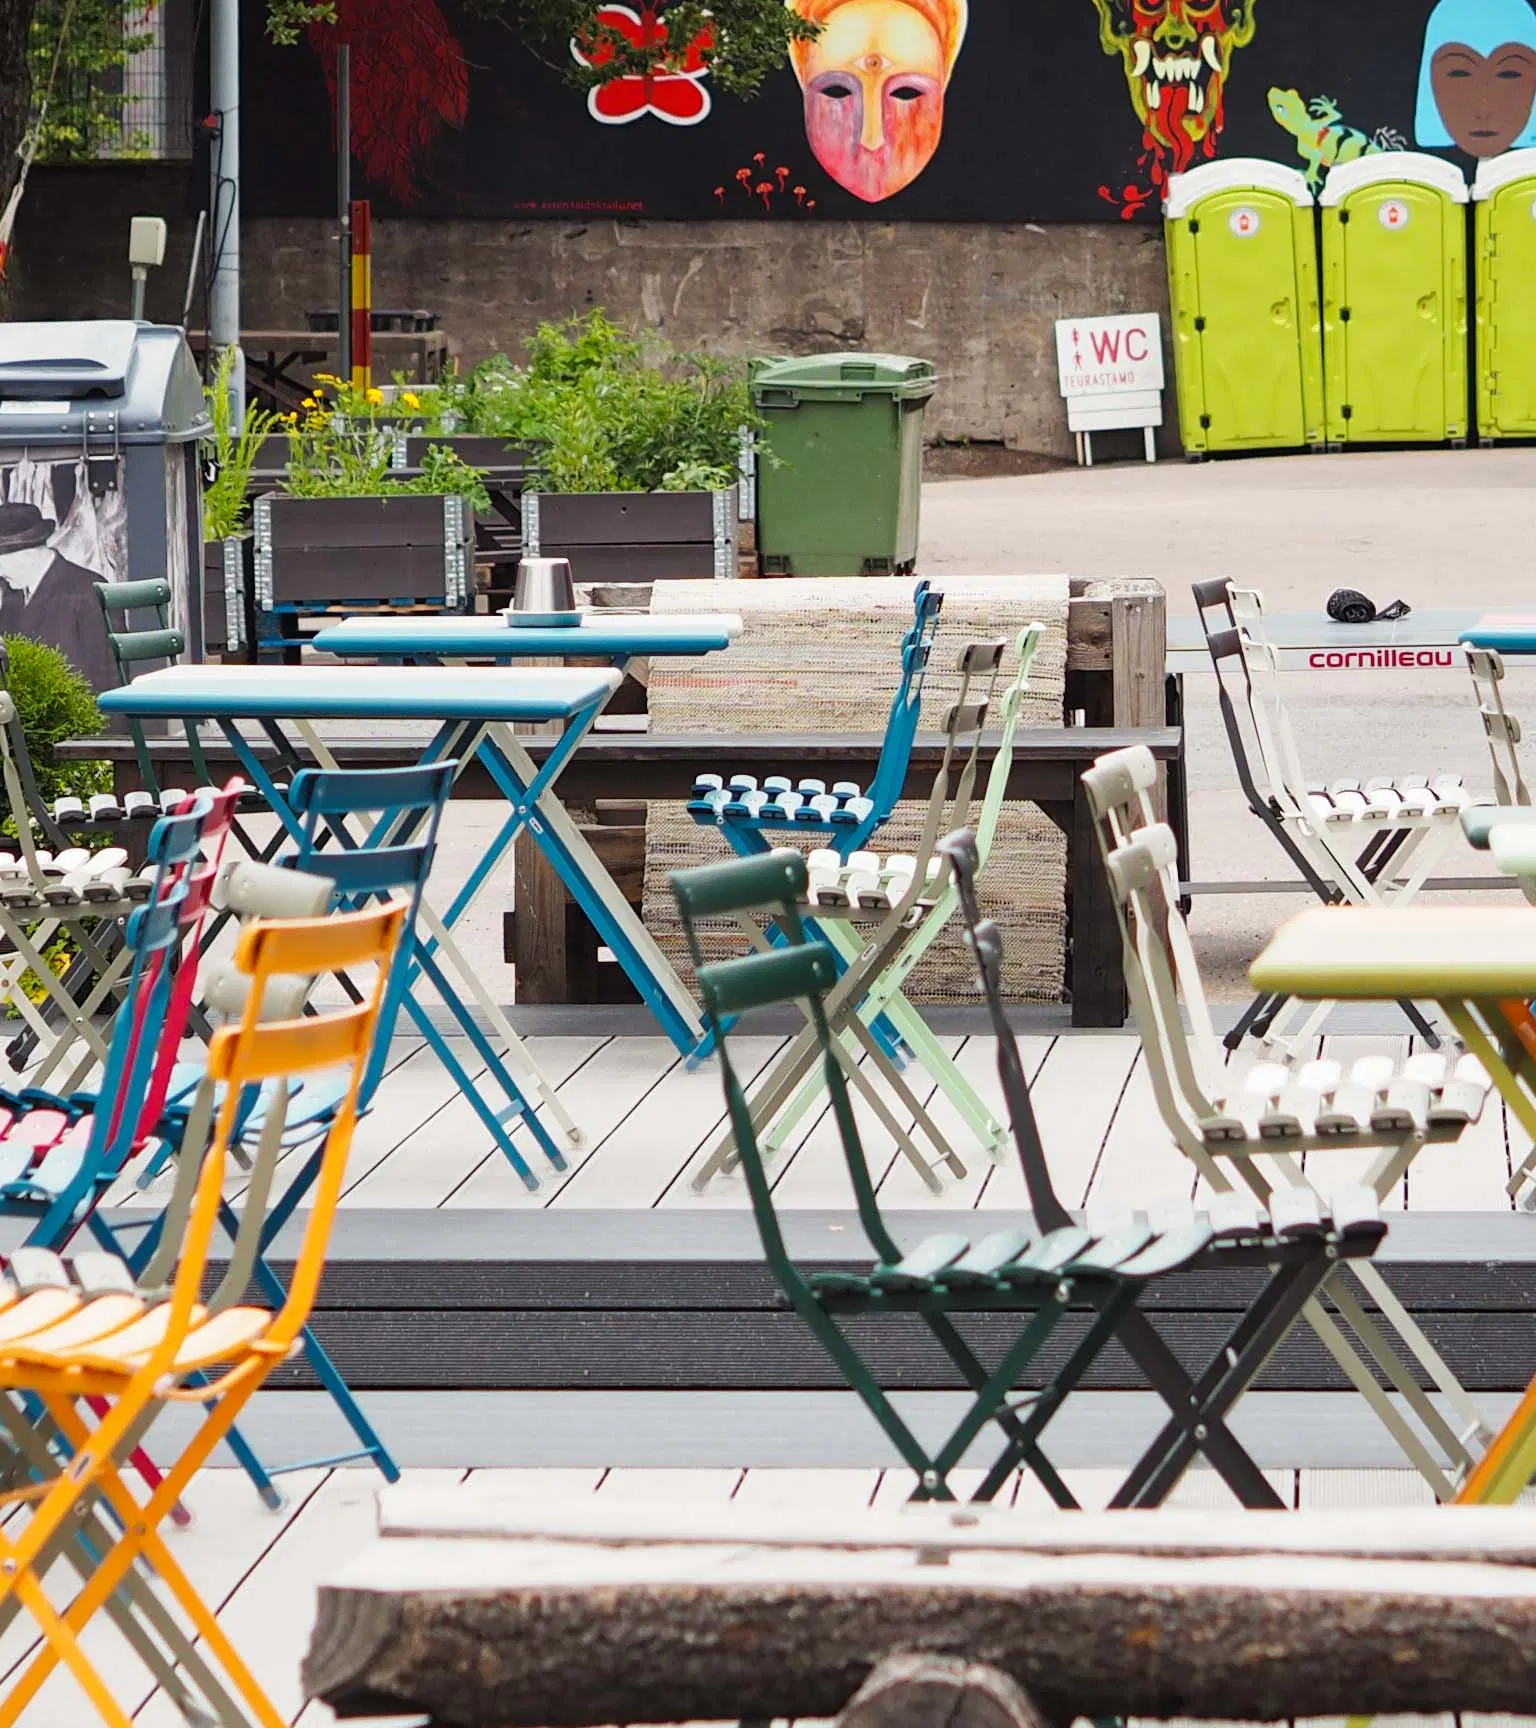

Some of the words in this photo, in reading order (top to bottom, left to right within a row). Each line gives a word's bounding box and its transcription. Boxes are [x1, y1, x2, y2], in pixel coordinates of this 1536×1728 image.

[1090, 328, 1148, 364] WC
[1064, 371, 1135, 389] TEURASTAMO
[1309, 649, 1452, 668] cornilleau
